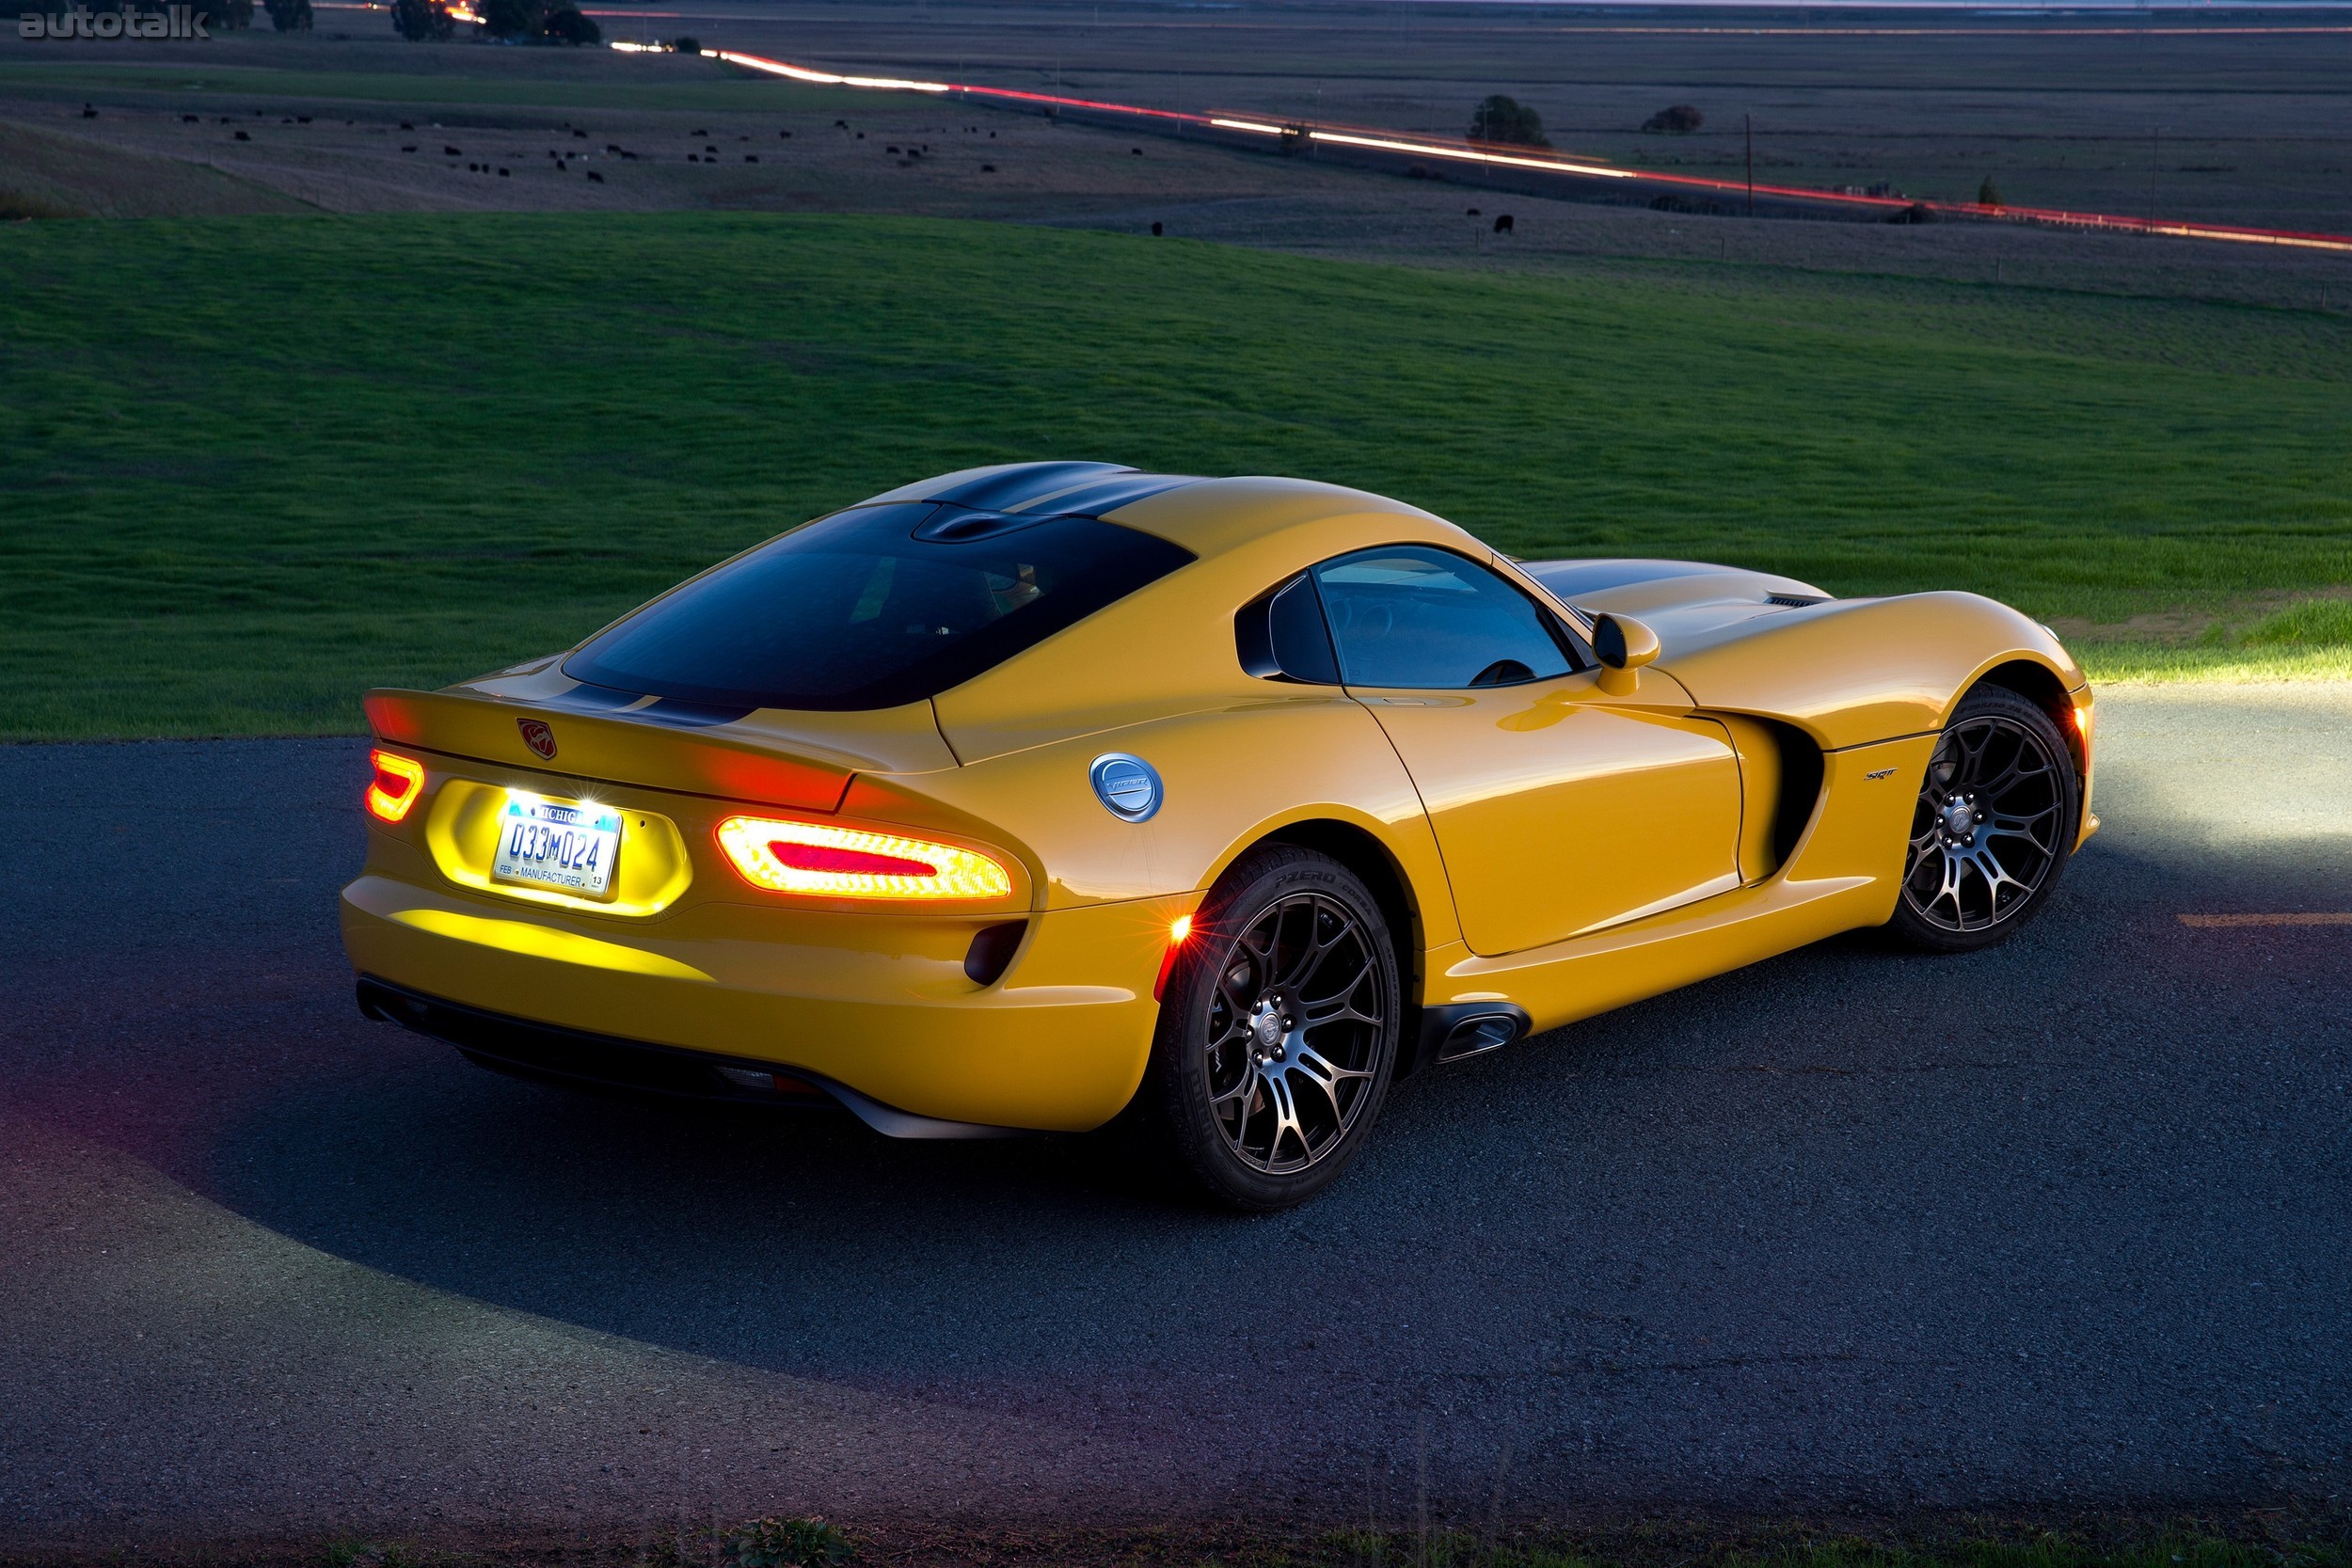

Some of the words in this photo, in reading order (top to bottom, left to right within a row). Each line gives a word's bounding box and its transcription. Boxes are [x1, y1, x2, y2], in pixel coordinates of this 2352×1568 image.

[1106, 777, 1148, 791] VIPER
[509, 822, 600, 873] 033M024
[500, 864, 512, 875] FEB
[520, 866, 581, 888] MANUFACTURER
[593, 876, 602, 885] 13
